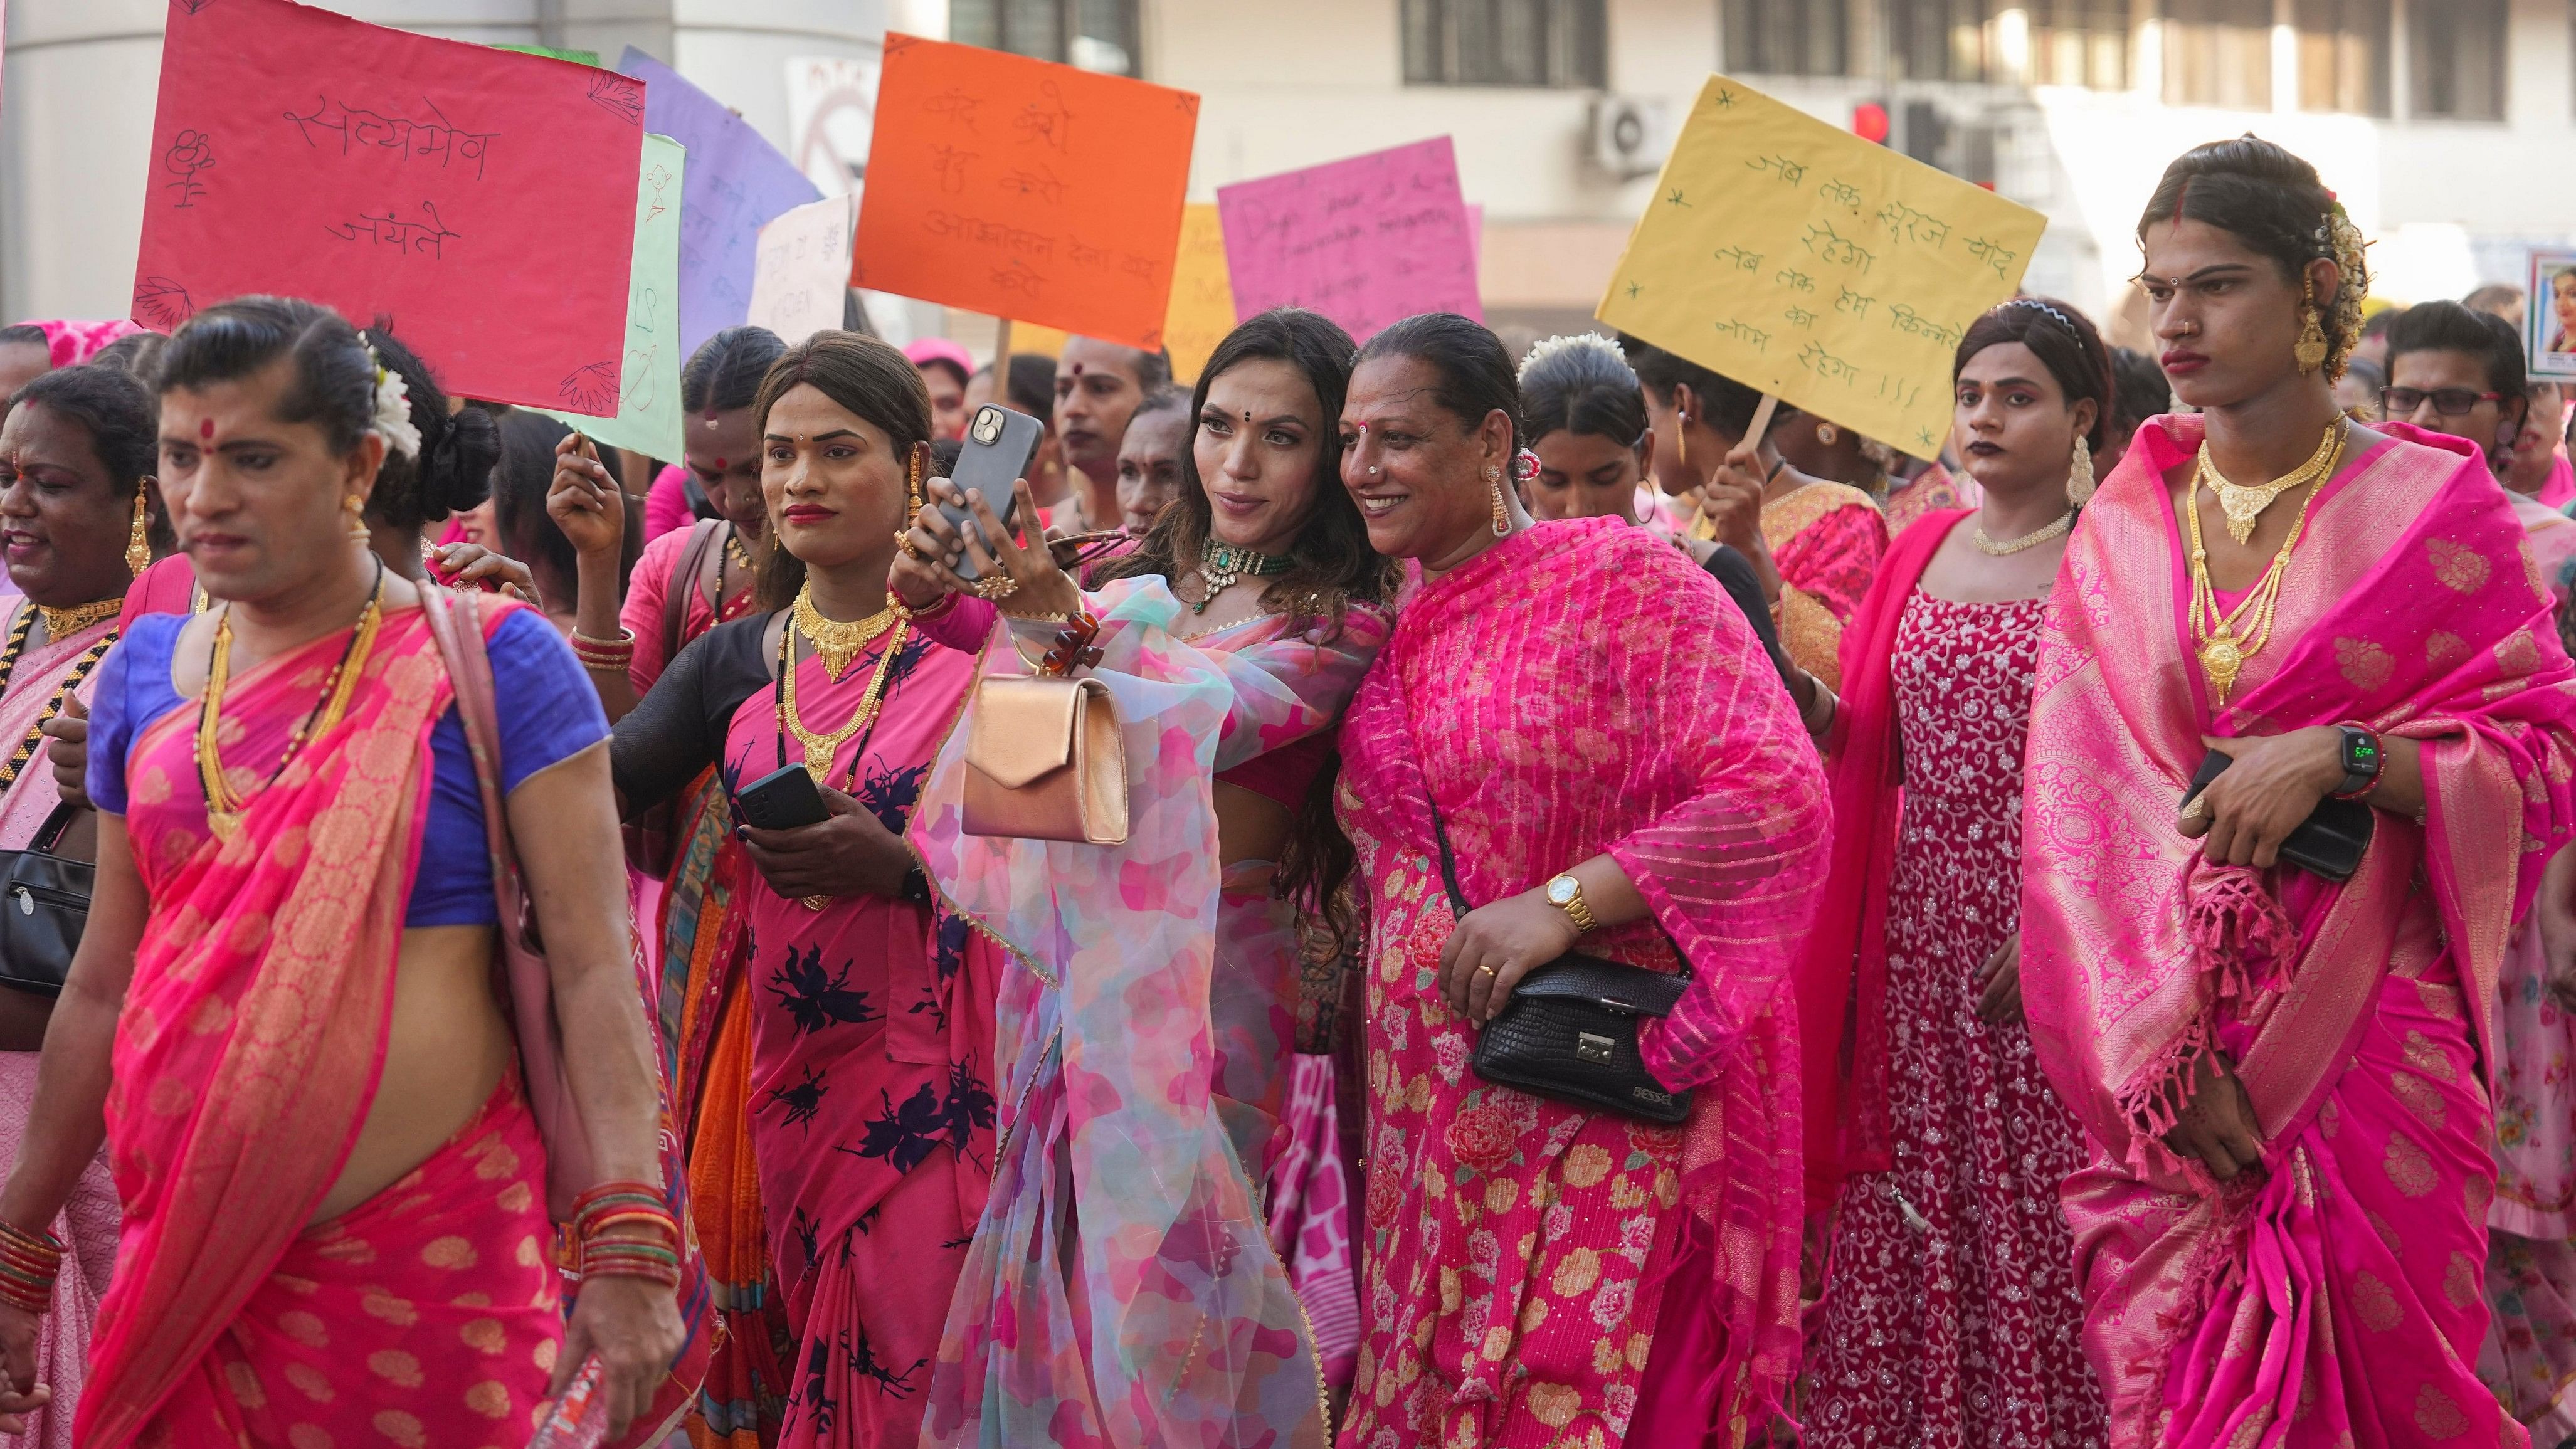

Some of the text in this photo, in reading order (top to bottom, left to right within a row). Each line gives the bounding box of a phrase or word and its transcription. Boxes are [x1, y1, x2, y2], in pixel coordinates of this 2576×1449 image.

[283, 95, 501, 181] सत्यमेव
[1745, 155, 1809, 186] जब
[1820, 178, 1861, 207] तक
[1877, 201, 1952, 249] सूरज
[1714, 245, 1764, 273] तब
[1775, 267, 1815, 293] तक
[1834, 284, 1876, 319] हम
[1784, 305, 1818, 330] का
[1715, 317, 1771, 354] नाम
